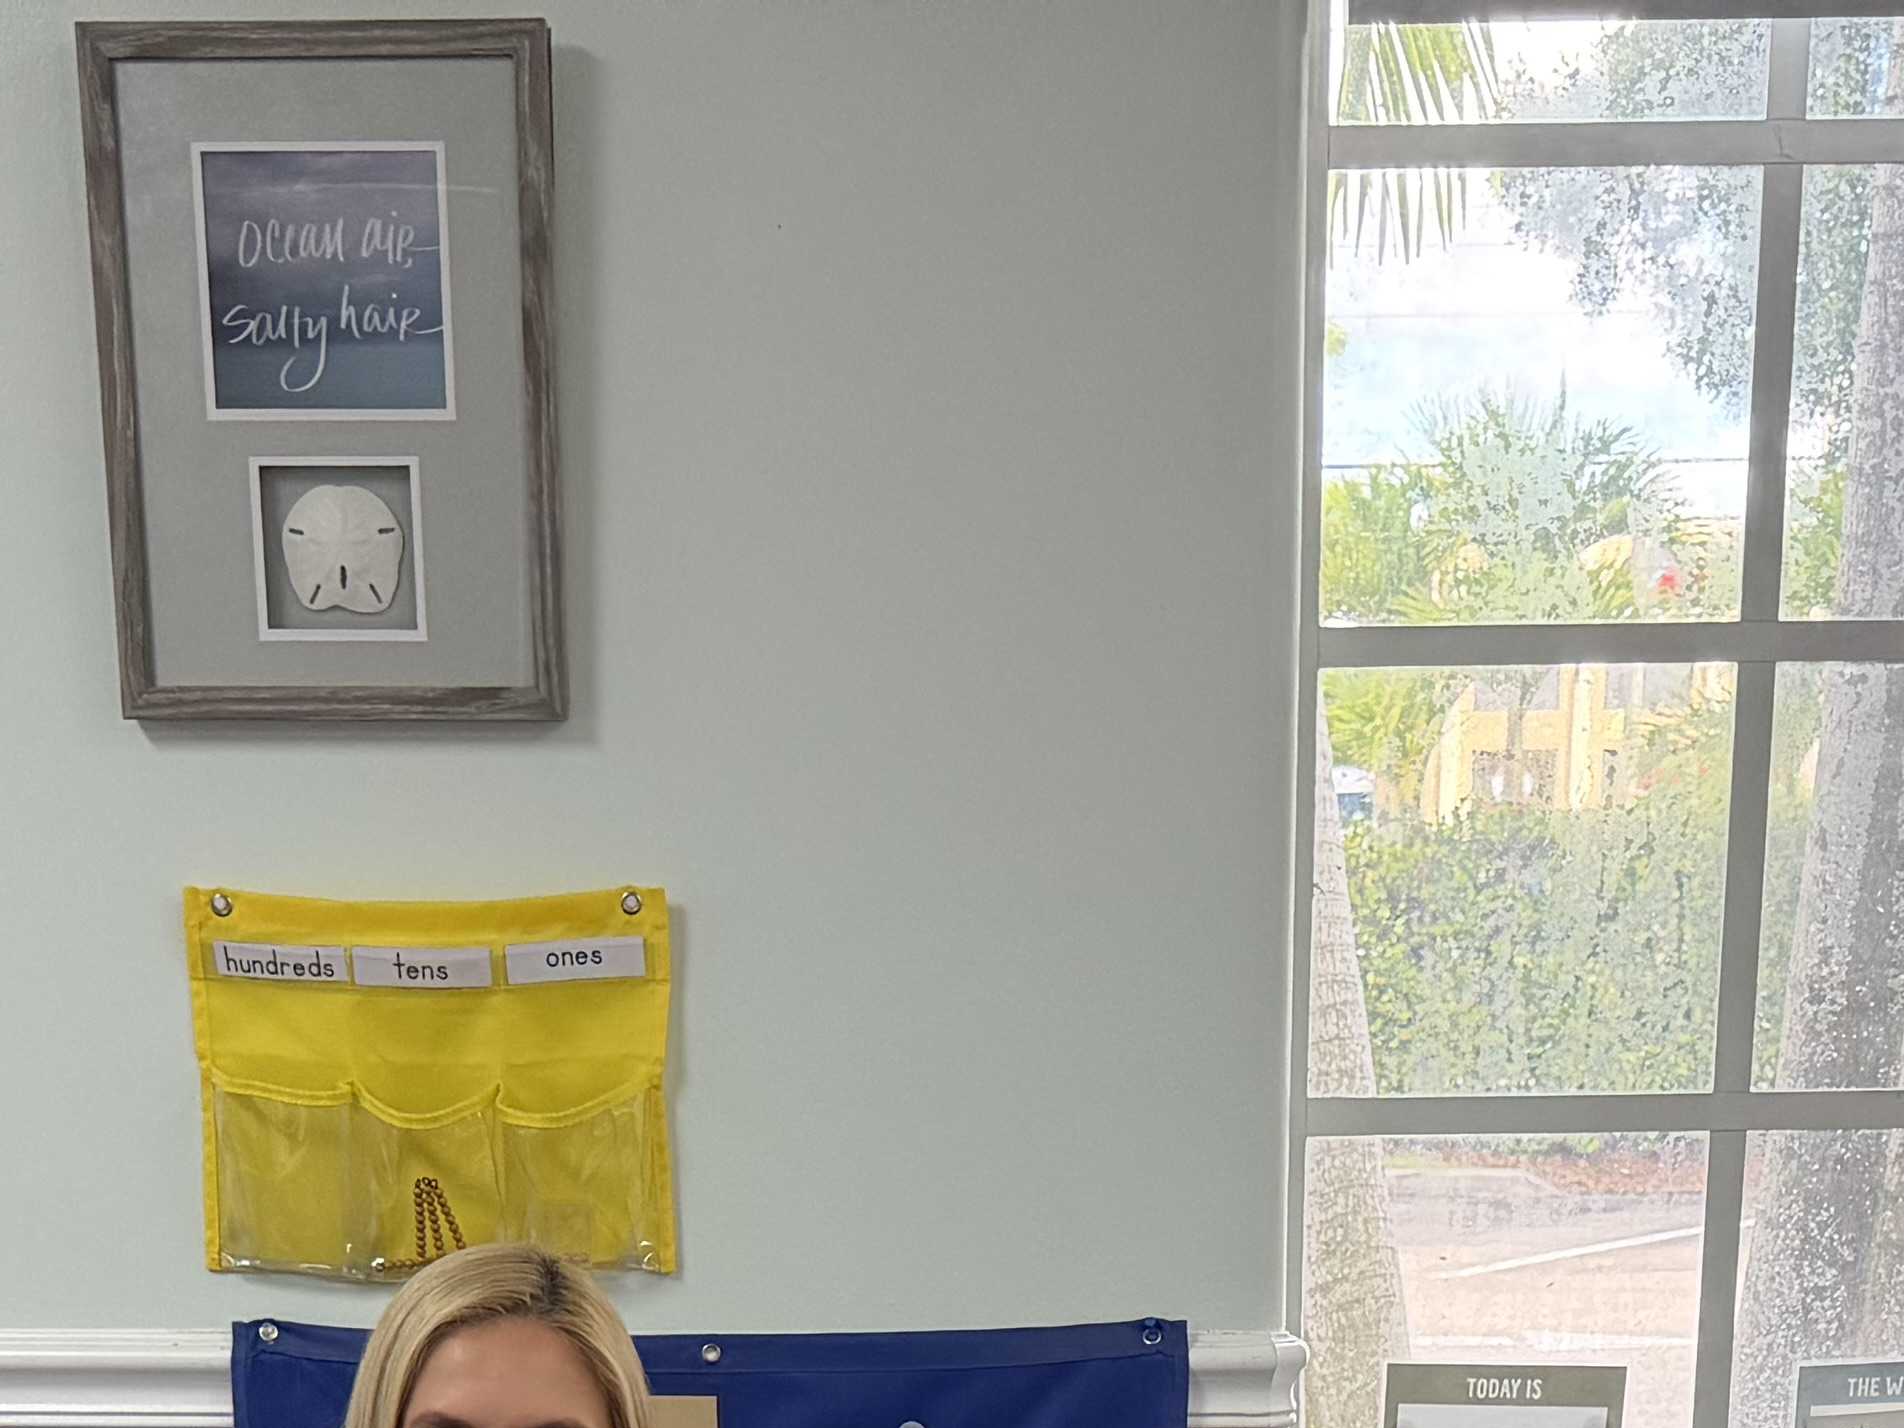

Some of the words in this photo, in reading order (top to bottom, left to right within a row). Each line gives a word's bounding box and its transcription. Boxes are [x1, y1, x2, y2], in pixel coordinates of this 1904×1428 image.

[223, 949, 336, 977] hundreds
[394, 952, 449, 980] tens
[546, 947, 603, 968] ones
[1466, 1378, 1522, 1399] TODAY
[1525, 1378, 1543, 1400] IS
[1847, 1377, 1881, 1397] THE
